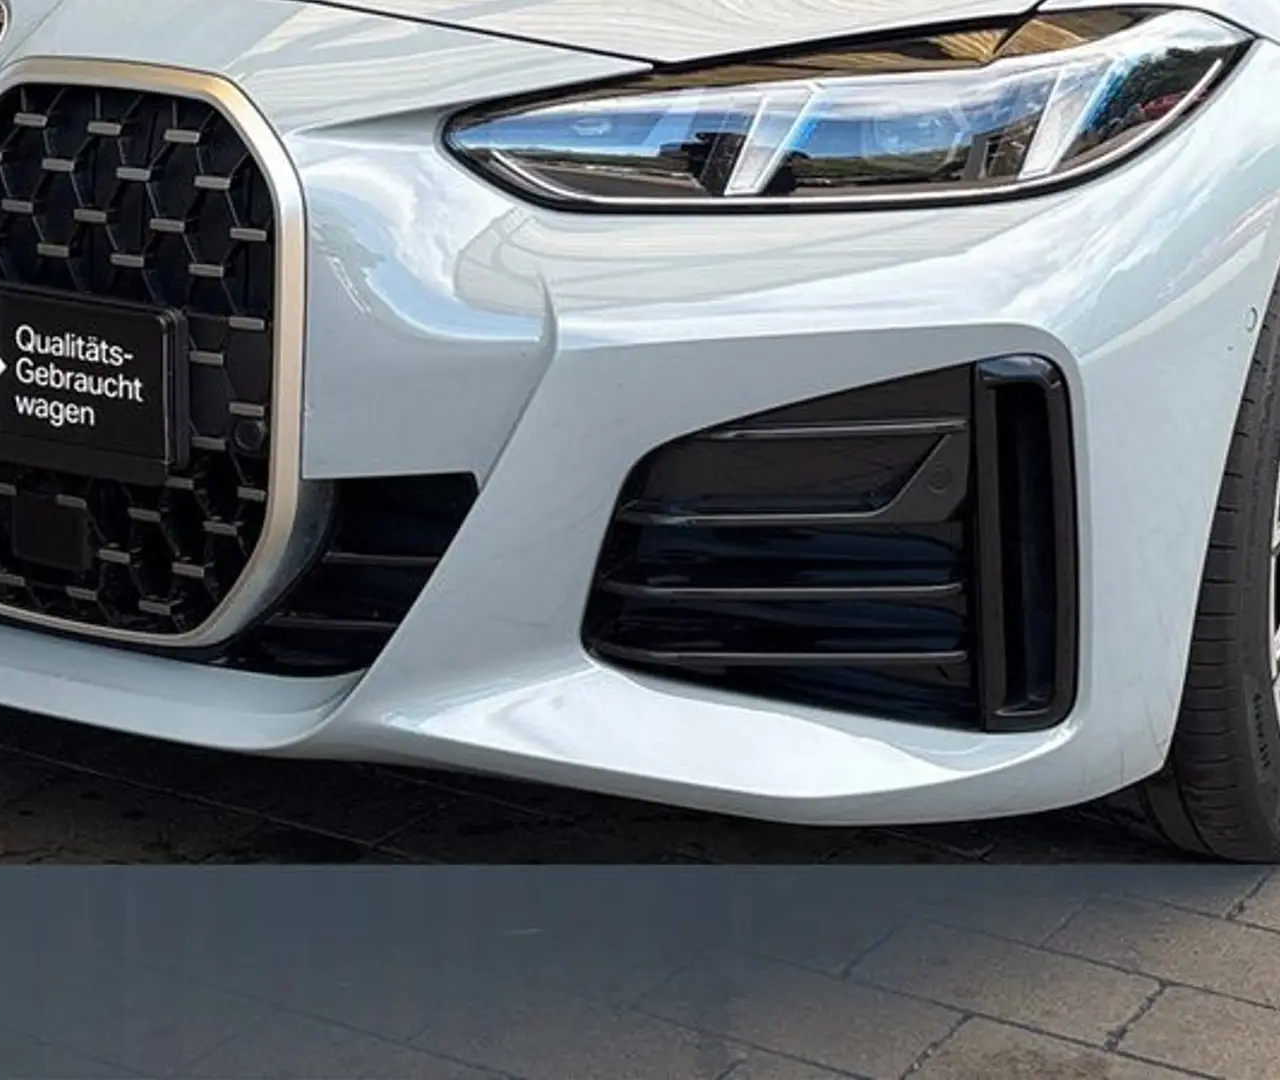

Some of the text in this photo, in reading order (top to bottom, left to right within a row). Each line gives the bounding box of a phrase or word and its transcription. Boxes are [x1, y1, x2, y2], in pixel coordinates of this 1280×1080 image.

[15, 324, 134, 366] Qualitäts-
[15, 357, 143, 402] Gebraucht
[14, 394, 95, 427] wagen
